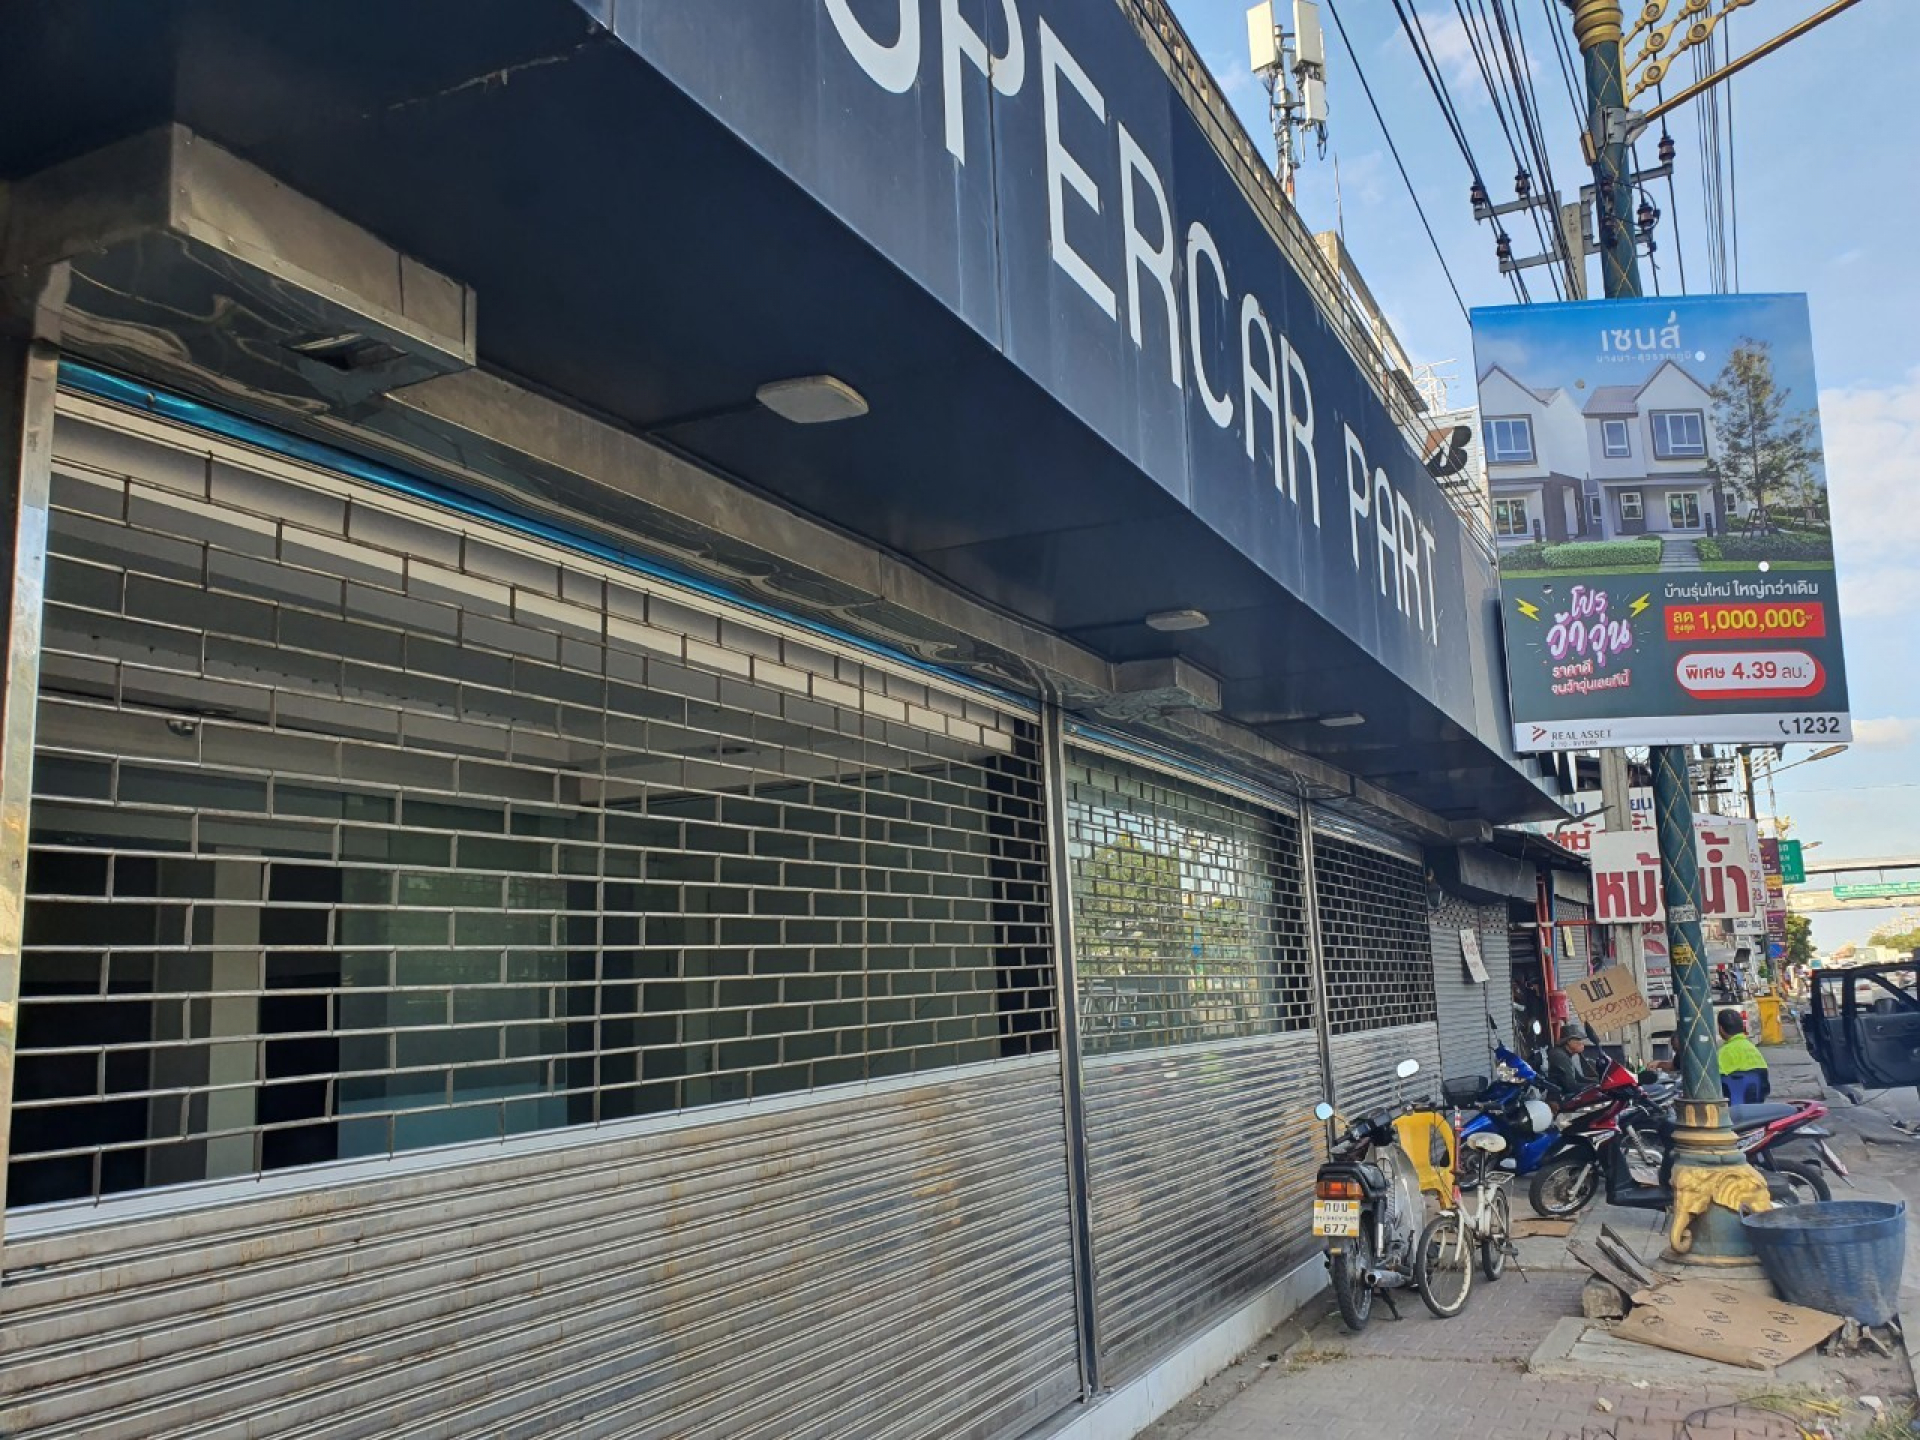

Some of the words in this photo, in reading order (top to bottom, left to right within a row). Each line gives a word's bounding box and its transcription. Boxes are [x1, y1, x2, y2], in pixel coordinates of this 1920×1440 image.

[1343, 420, 1438, 646] PART
[1664, 582, 1731, 601] บ้านรุ่นใหม่
[1732, 579, 1818, 598] ใหญ่กว่าเดิม
[1673, 611, 1694, 623] ลด
[1699, 608, 1806, 633] 1,000,000
[1685, 664, 1725, 680] พิเศษ
[1732, 661, 1777, 679] 4.39
[1792, 716, 1841, 734] 1232
[1552, 731, 1578, 740] REAL
[1581, 729, 1612, 739] ASSET
[1324, 1223, 1348, 1234] 677
